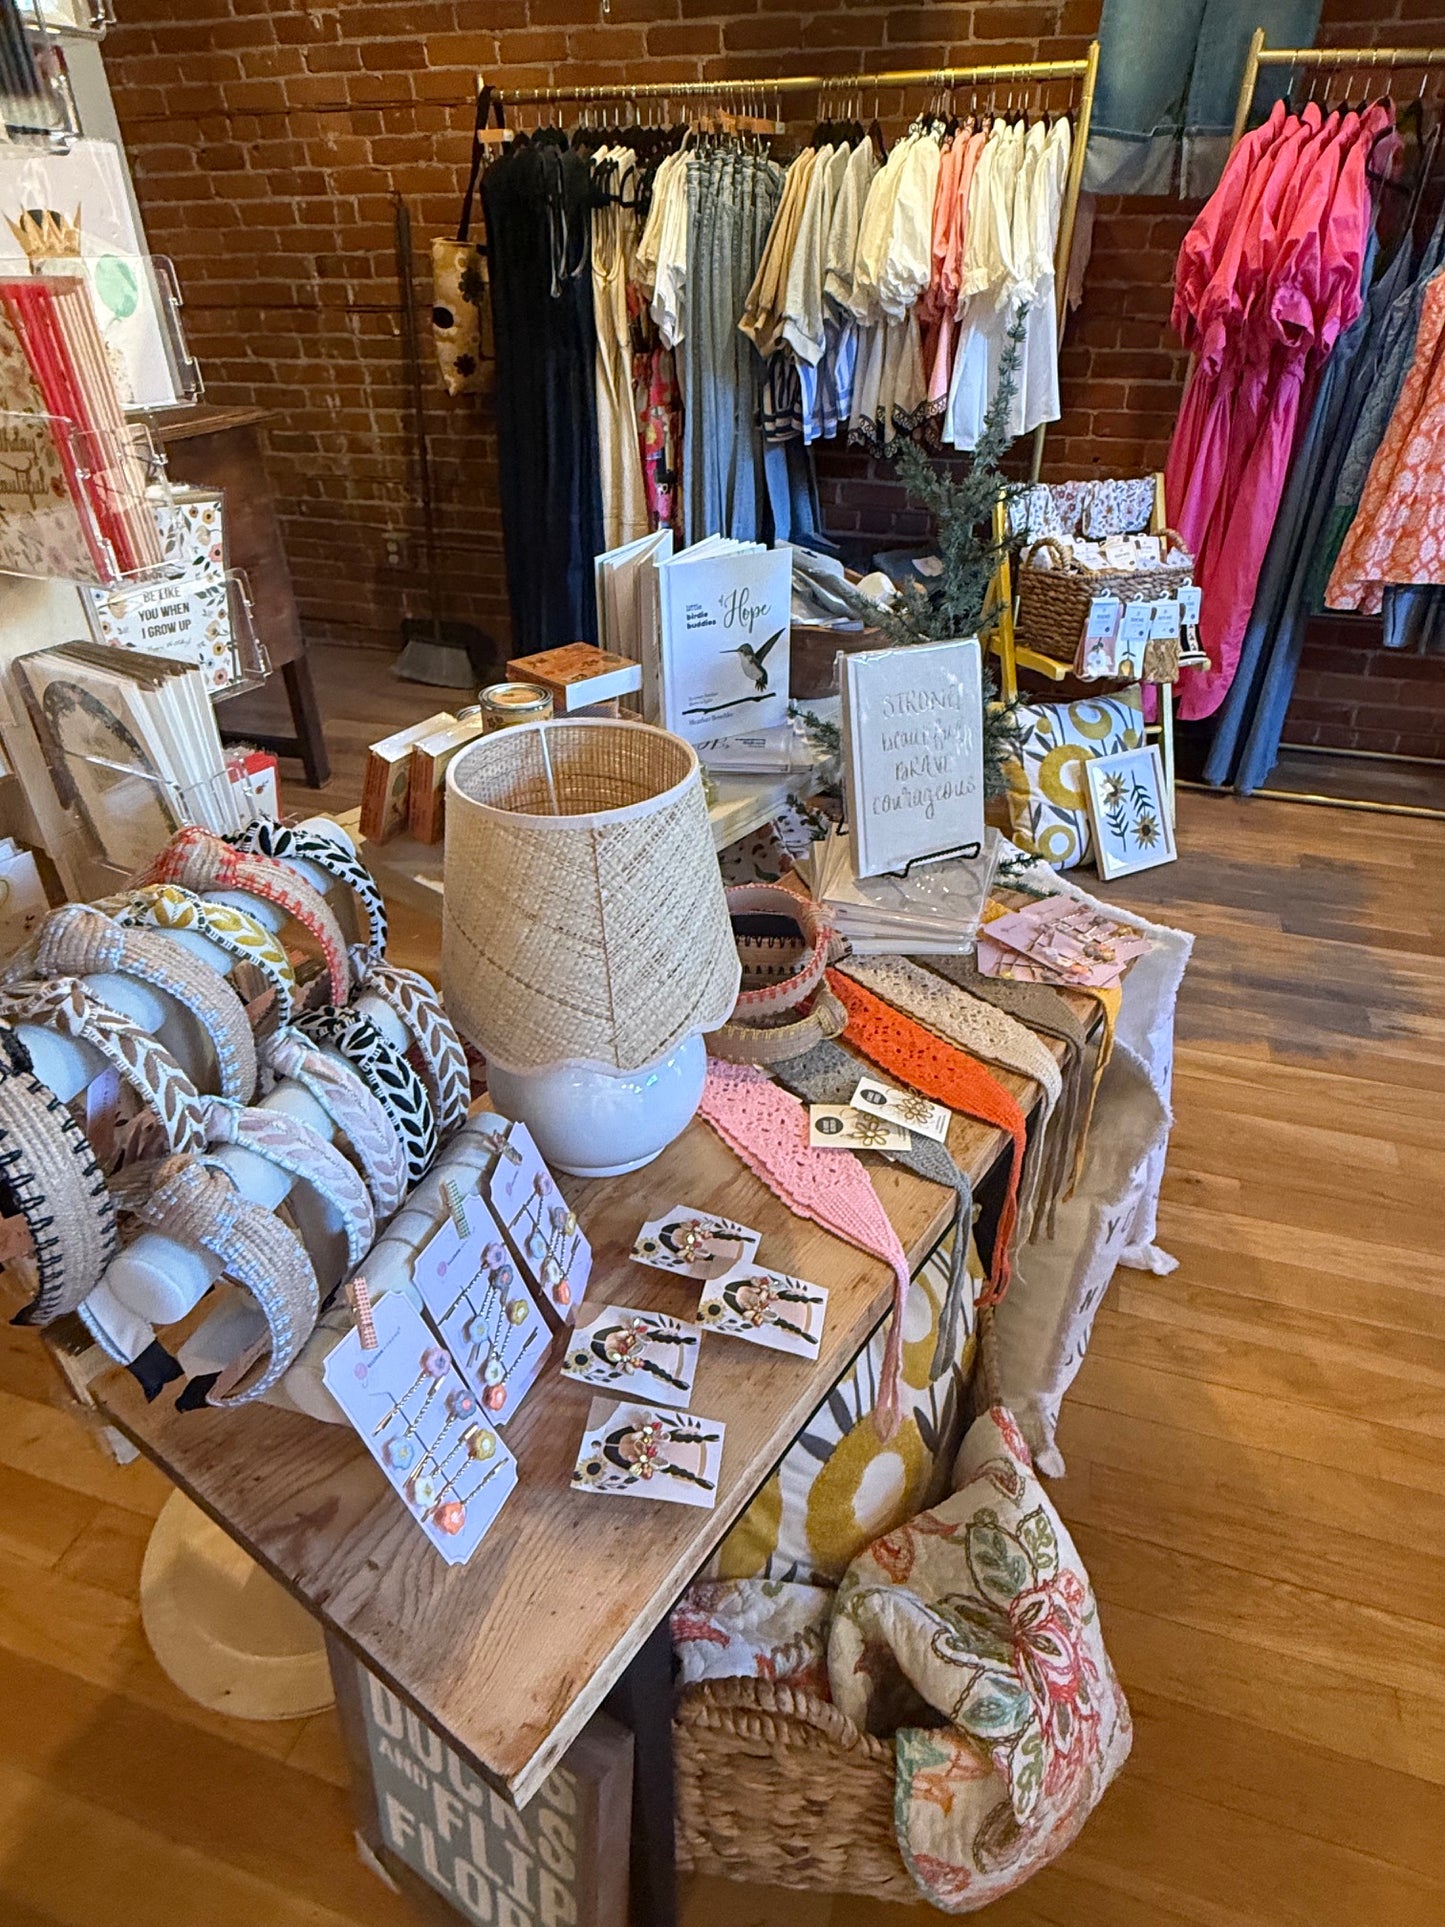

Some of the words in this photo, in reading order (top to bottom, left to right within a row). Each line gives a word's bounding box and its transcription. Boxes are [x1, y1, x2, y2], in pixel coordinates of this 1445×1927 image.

[157, 586, 181, 600] LIKE
[138, 608, 159, 622] YOU
[161, 602, 190, 618] WHEN
[686, 612, 708, 621] birdie
[724, 586, 772, 634] Hope
[147, 622, 176, 638] GROW
[178, 619, 192, 632] UP
[687, 619, 716, 630] buddies
[882, 684, 961, 718] STRONG
[378, 1736, 428, 1791] AND
[432, 1780, 578, 1926] FLIP
